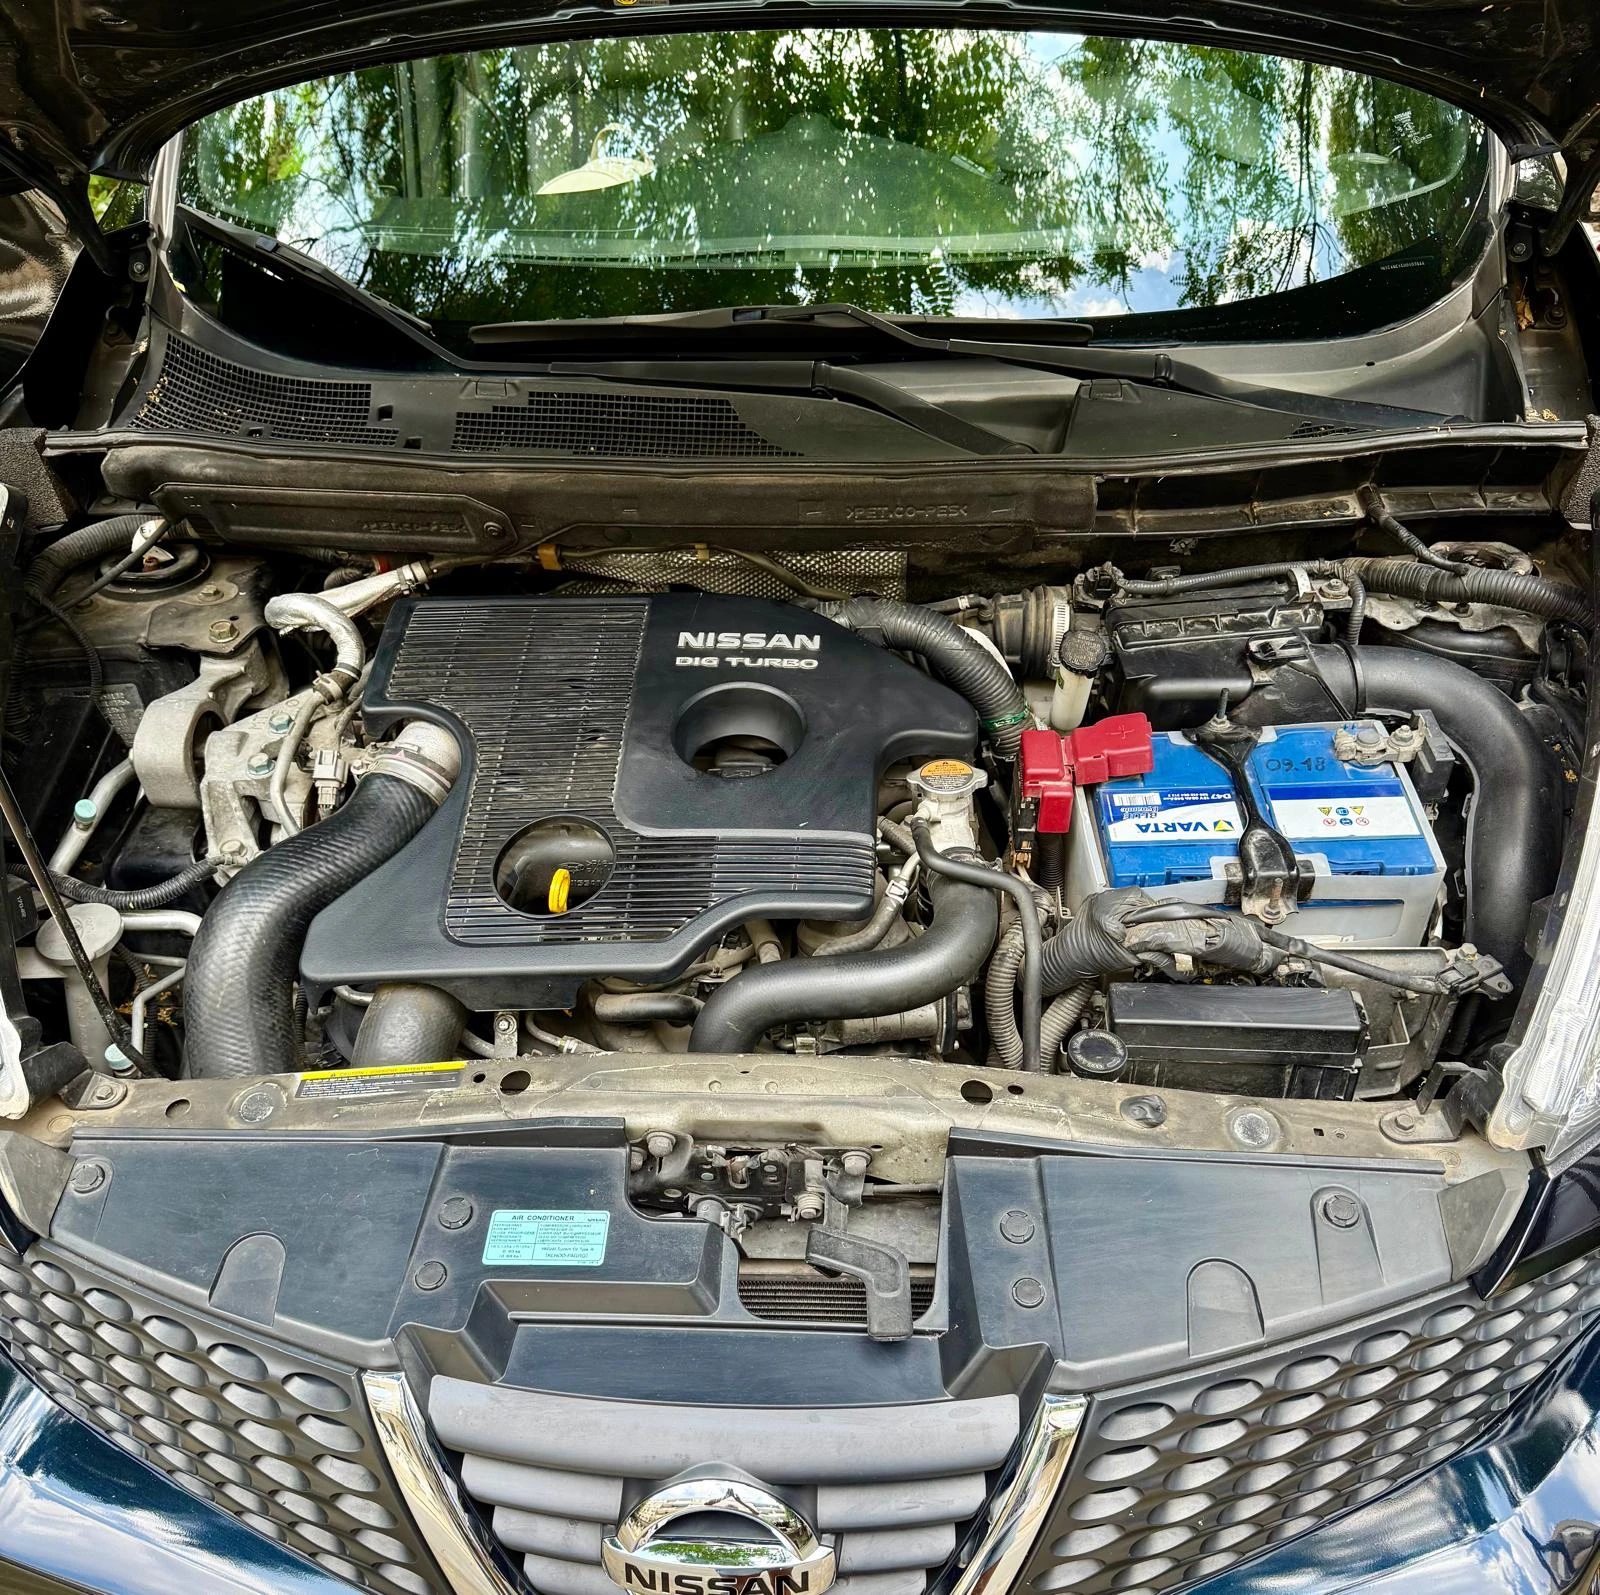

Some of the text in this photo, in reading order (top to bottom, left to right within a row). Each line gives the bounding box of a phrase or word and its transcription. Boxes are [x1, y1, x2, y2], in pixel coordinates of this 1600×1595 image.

[677, 631, 821, 650] NISSAN
[675, 656, 819, 669] DIG TURBO
[1135, 821, 1209, 834] VARTA
[624, 1562, 809, 1595] NISSAN
